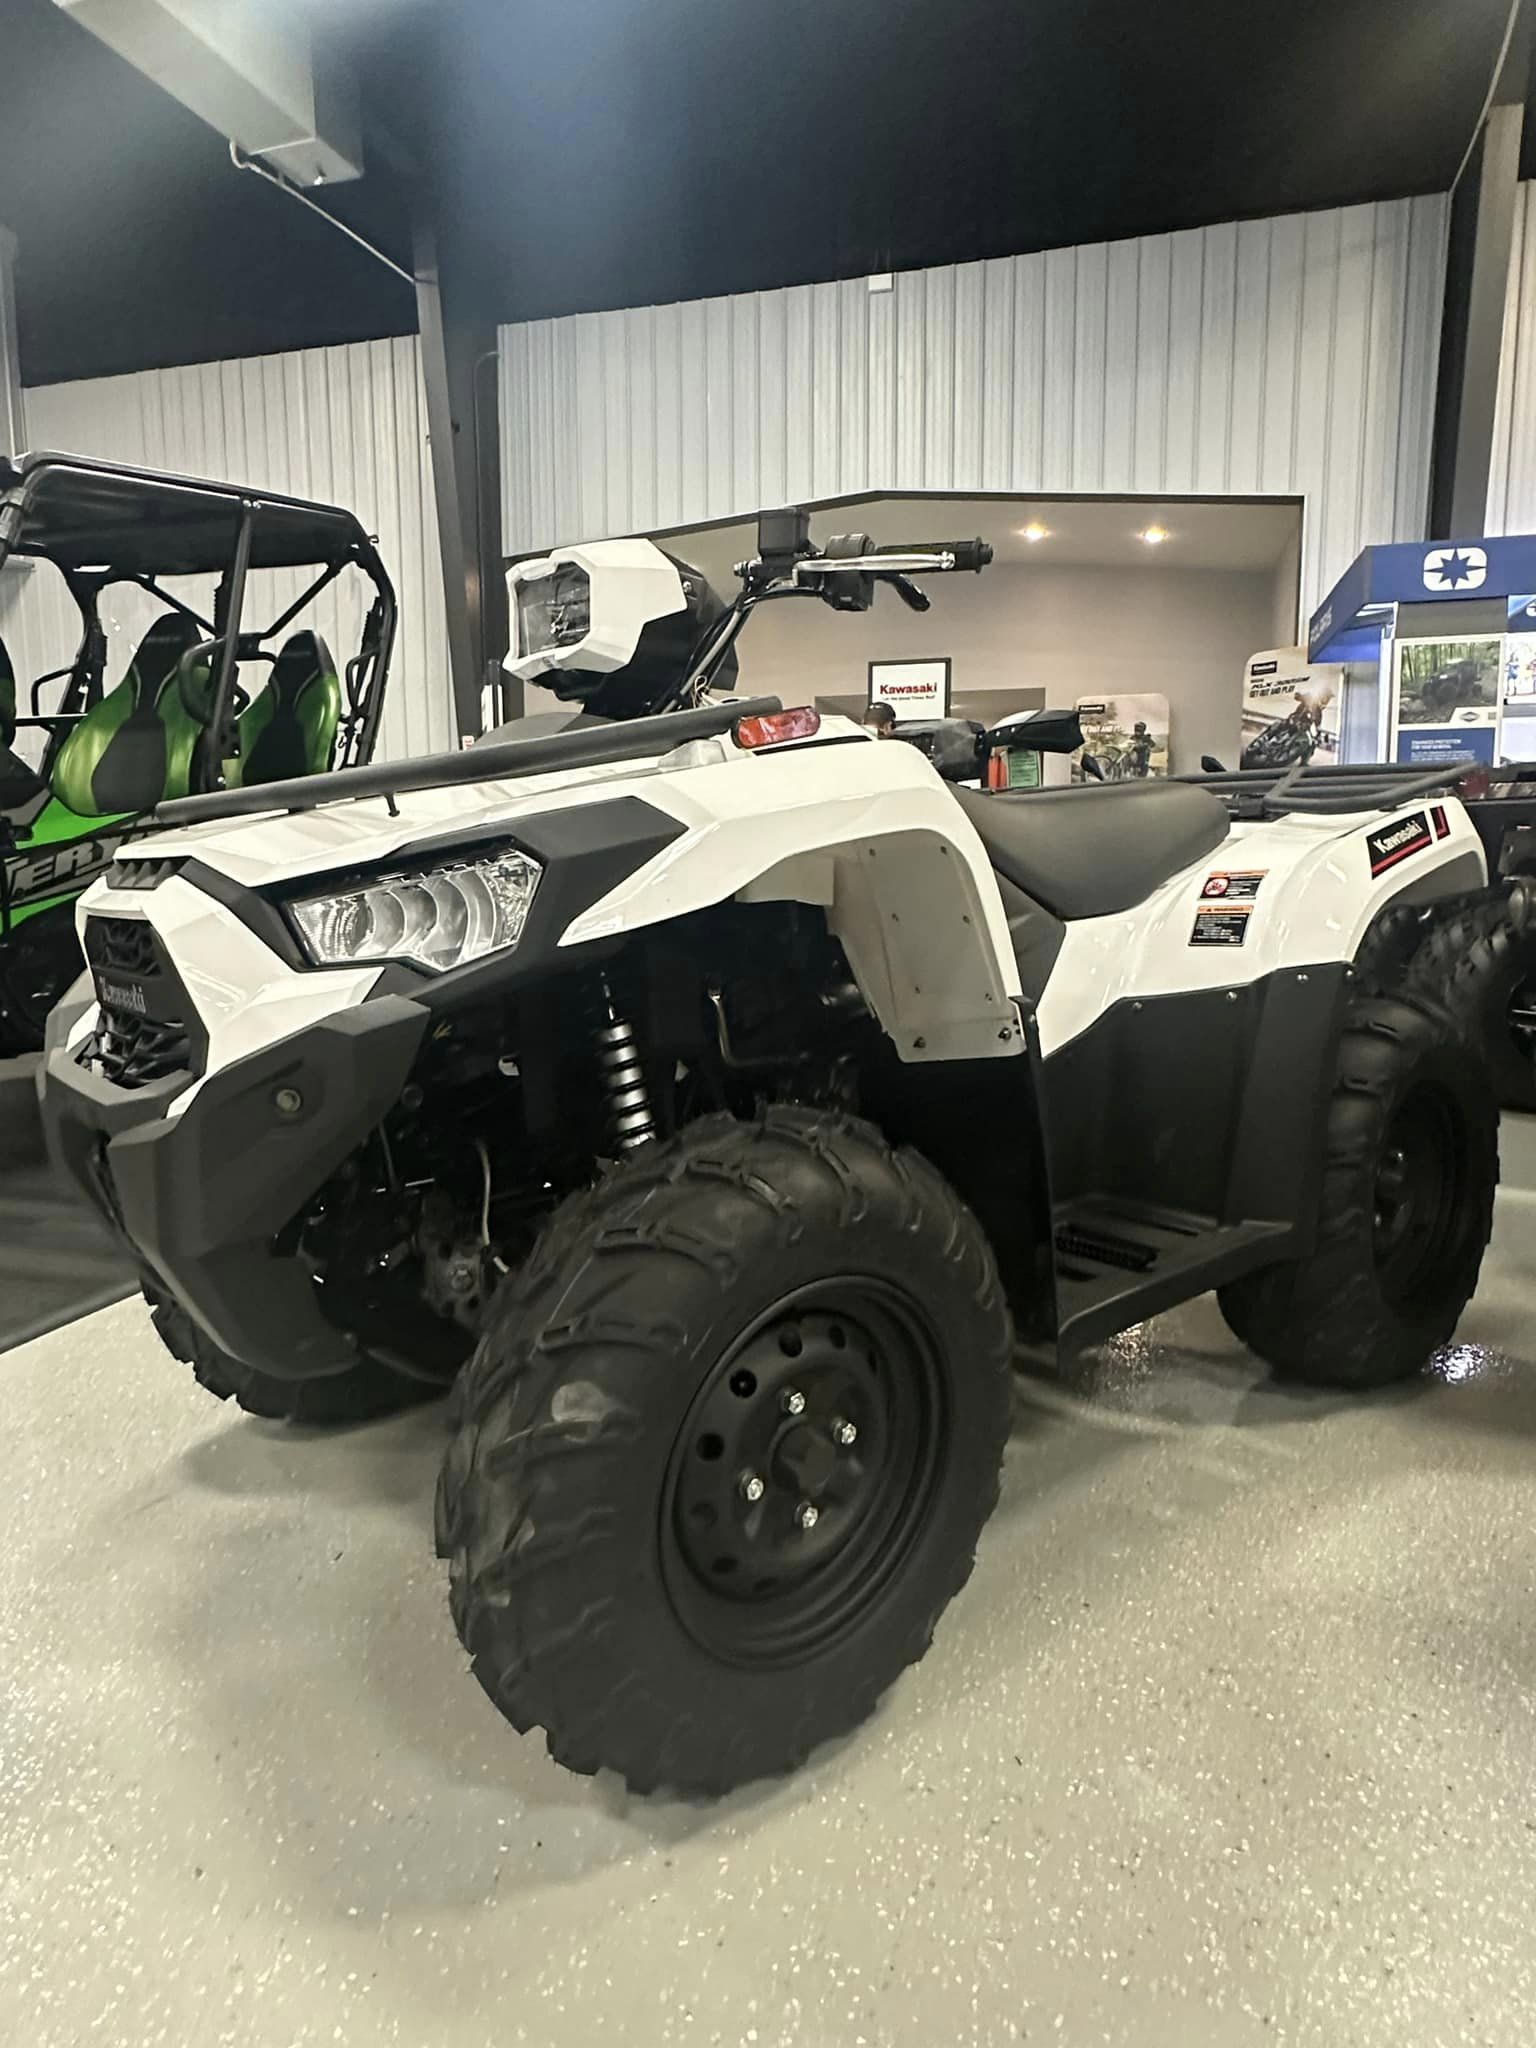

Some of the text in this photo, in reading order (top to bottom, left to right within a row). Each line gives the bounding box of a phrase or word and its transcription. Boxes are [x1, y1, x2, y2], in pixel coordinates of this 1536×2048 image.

[880, 682, 937, 695] Kawasaki
[1373, 819, 1423, 854] Kawasaki
[4, 833, 142, 897] TERY
